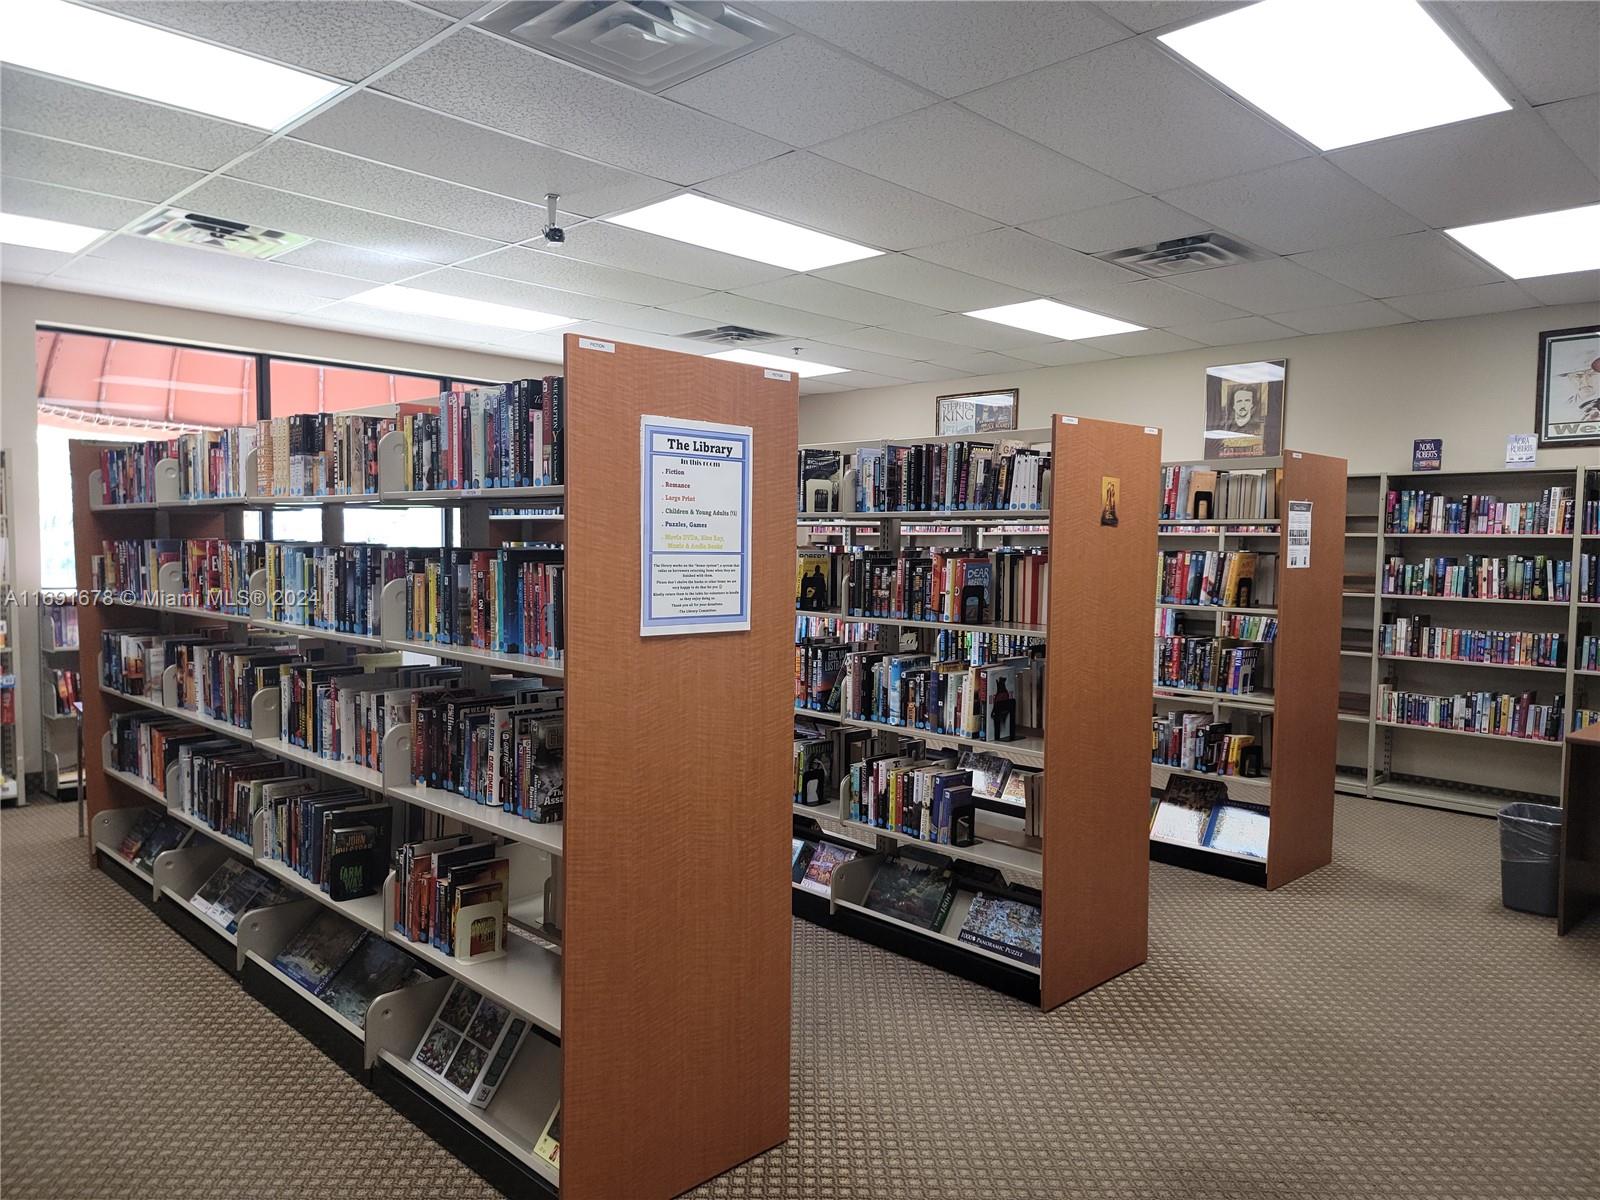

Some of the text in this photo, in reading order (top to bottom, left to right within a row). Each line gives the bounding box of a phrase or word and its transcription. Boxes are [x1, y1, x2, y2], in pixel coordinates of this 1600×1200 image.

[943, 409, 974, 422] KING
[667, 438, 733, 458] The Library
[1419, 443, 1435, 451] NORA
[1416, 450, 1438, 459] ROBERTS
[665, 481, 691, 489] Romance
[665, 494, 681, 503] Large
[695, 509, 712, 517] Young
[967, 567, 989, 579] DEAR
[976, 937, 1005, 951] PANORAMIC
[1004, 946, 1024, 958] PUZZLE
